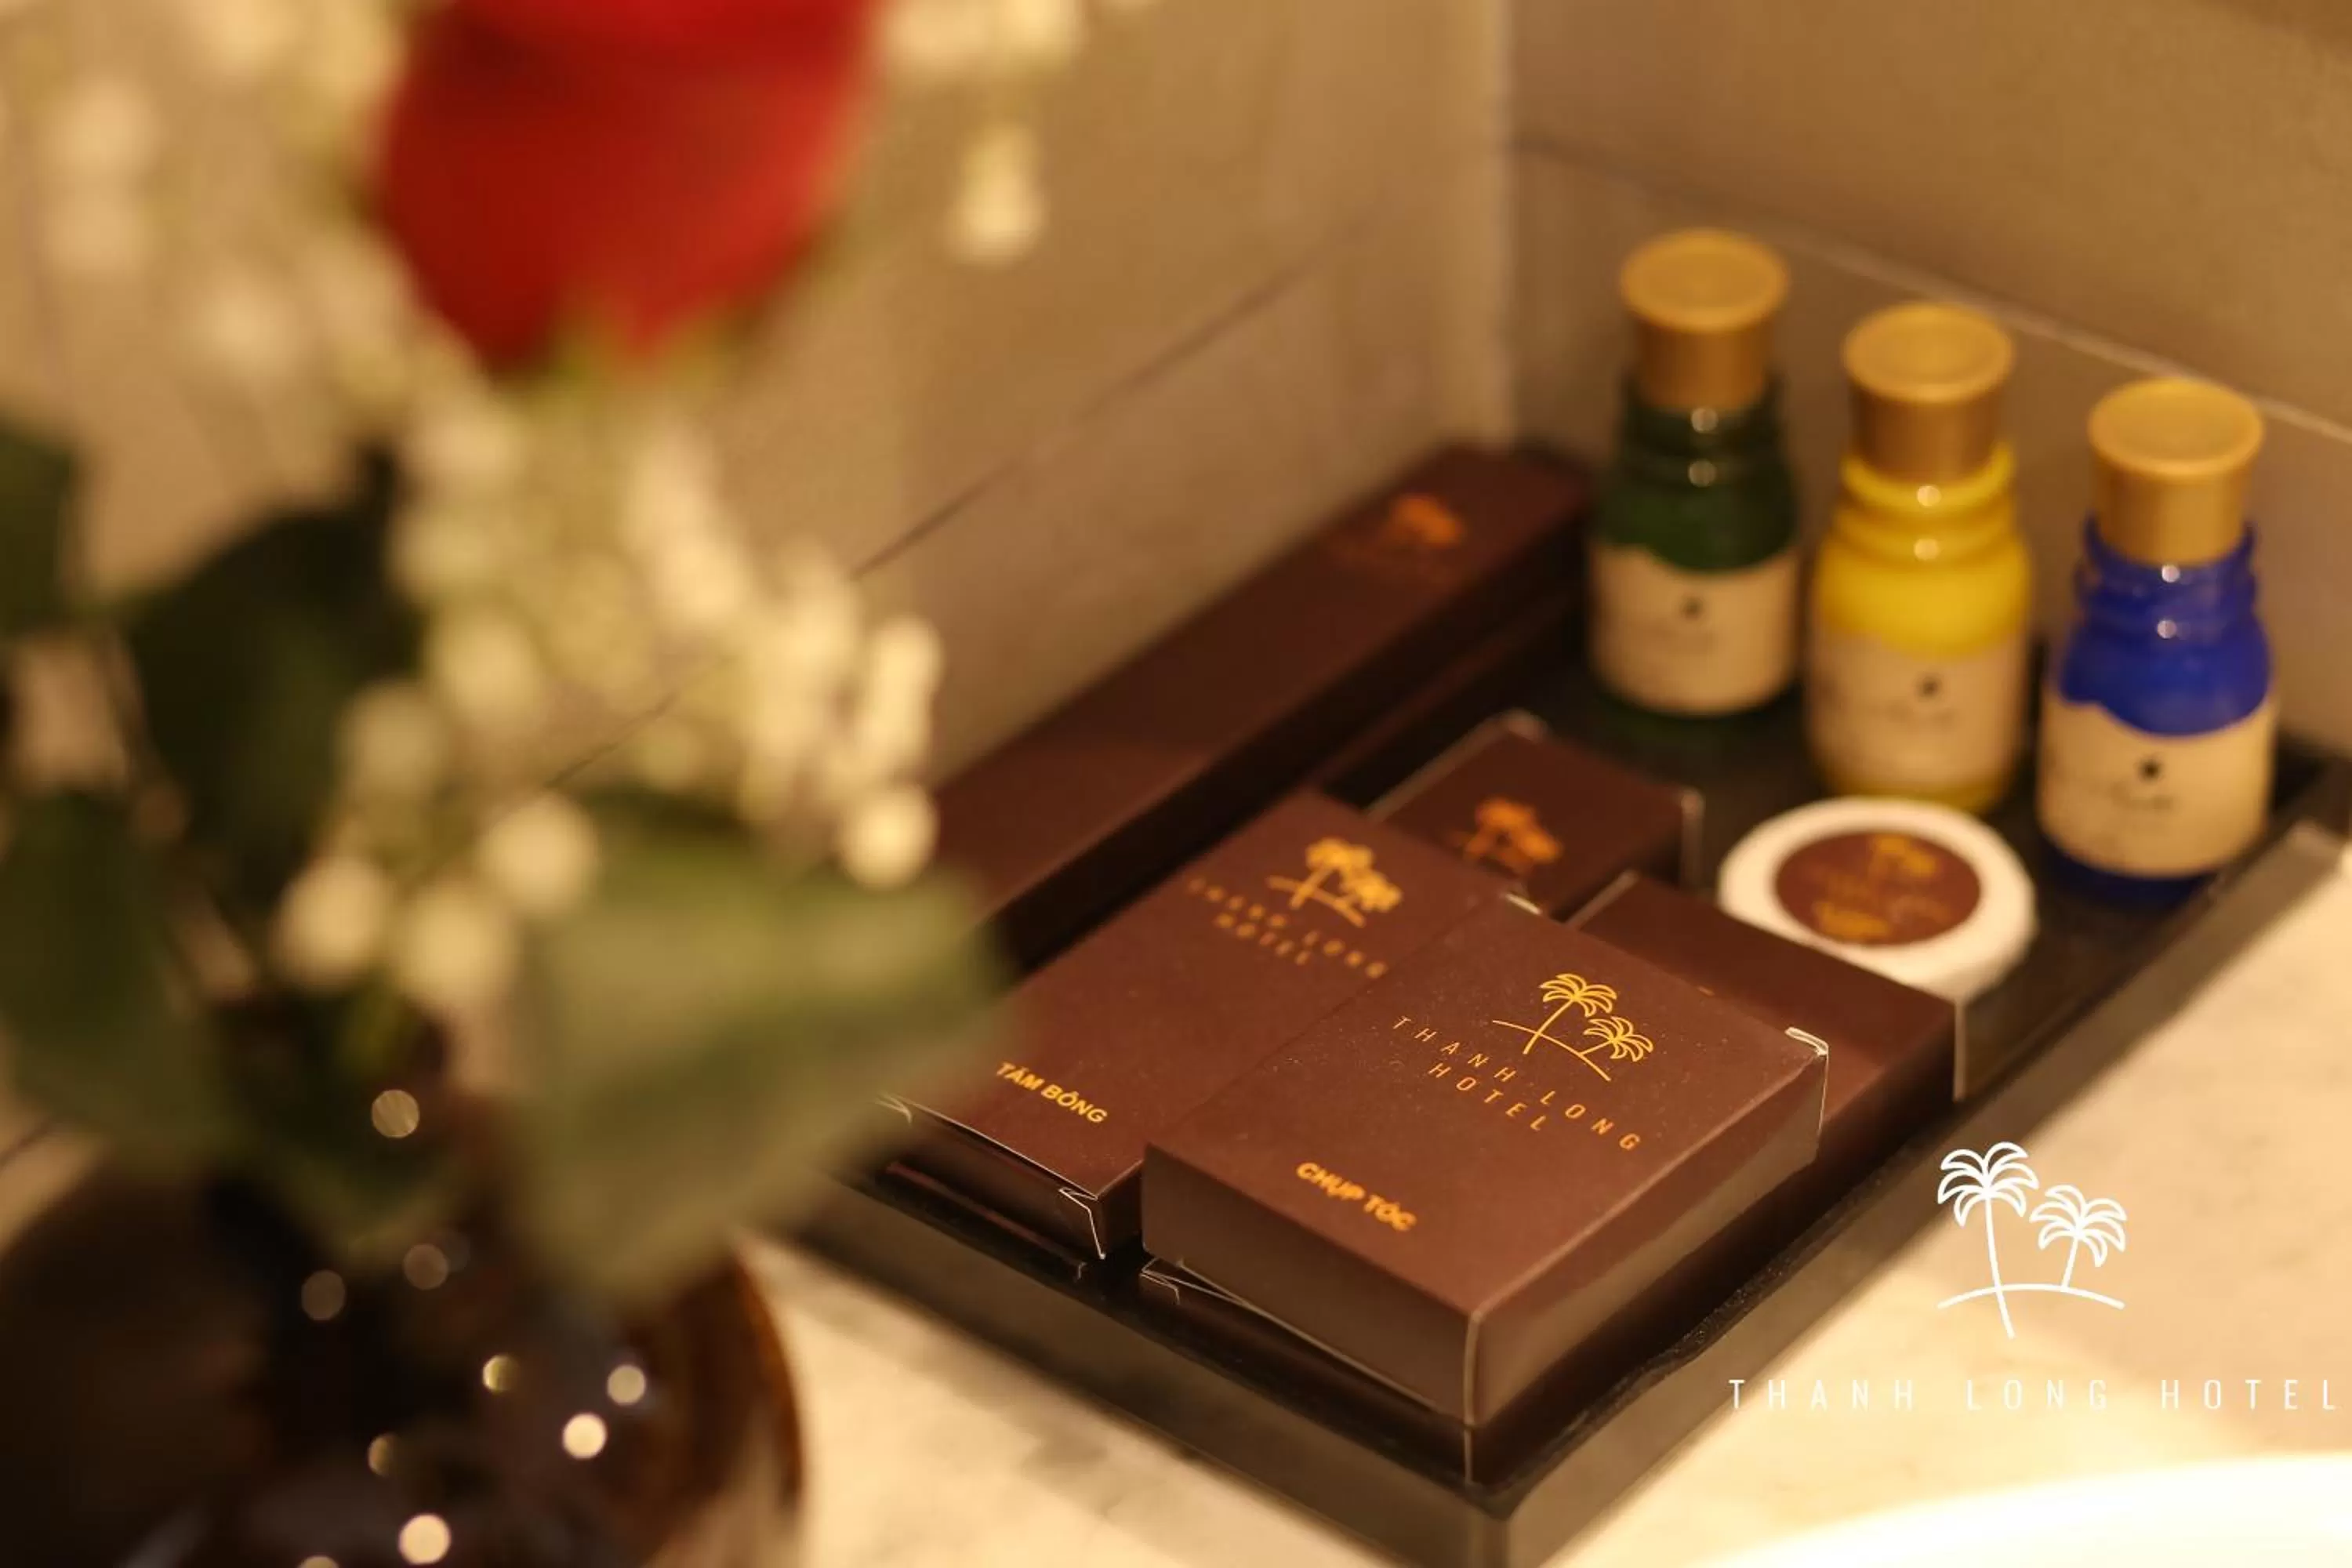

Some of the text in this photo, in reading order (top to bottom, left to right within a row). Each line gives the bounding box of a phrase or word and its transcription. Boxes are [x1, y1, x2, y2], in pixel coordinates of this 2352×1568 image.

[1040, 1083, 1108, 1123] BÔNG
[1392, 1014, 1641, 1151] THANH LONG
[1428, 1062, 1548, 1131] HOTEL
